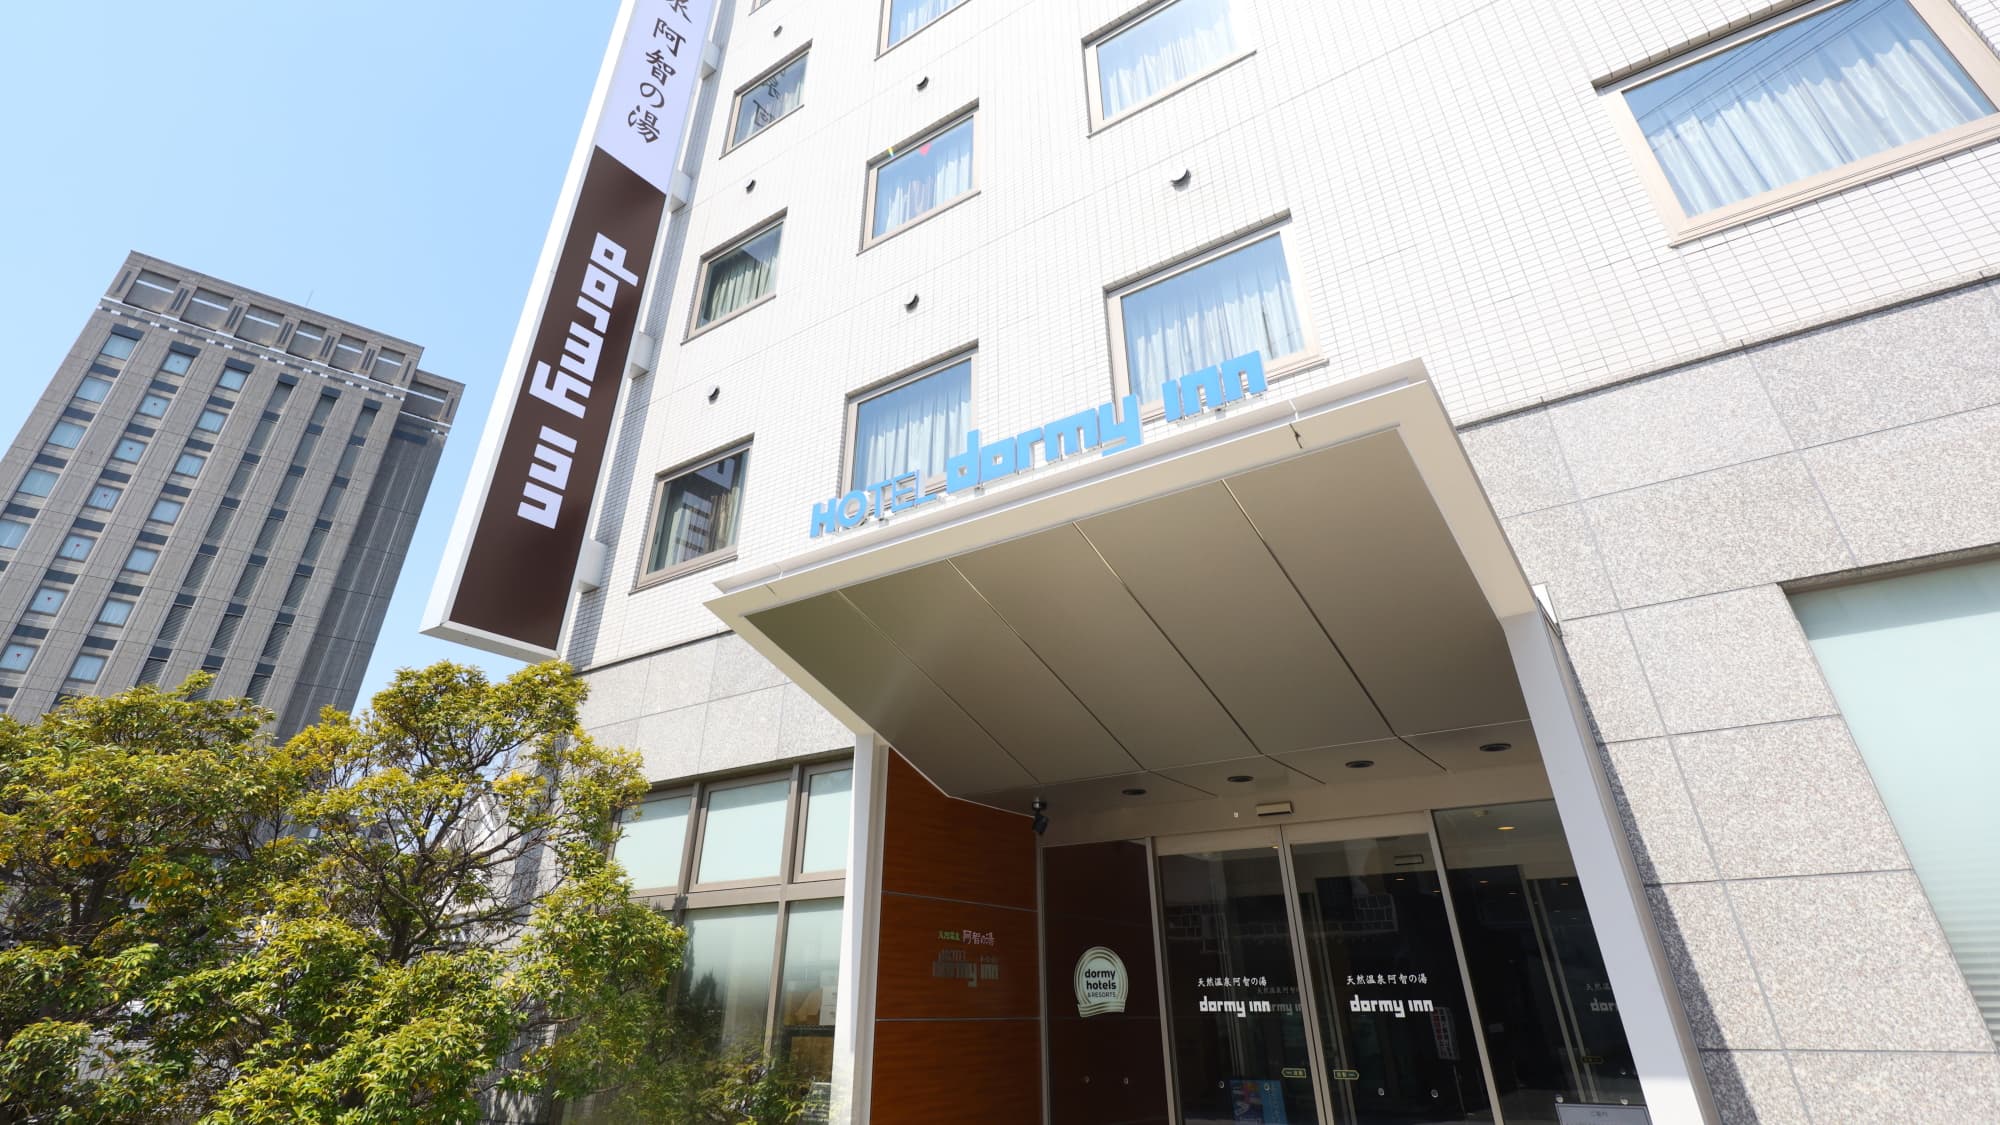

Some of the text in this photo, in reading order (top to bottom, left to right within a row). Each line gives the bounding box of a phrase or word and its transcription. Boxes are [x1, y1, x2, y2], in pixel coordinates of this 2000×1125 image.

[517, 232, 639, 529] dormy inn
[810, 350, 1268, 539] HOTEL dormy inn
[1084, 968, 1116, 981] dormy
[1086, 980, 1117, 991] hotels
[1199, 995, 1271, 1018] dormy inn
[1349, 994, 1434, 1018] dormy inn
[1590, 997, 1616, 1012] dor
